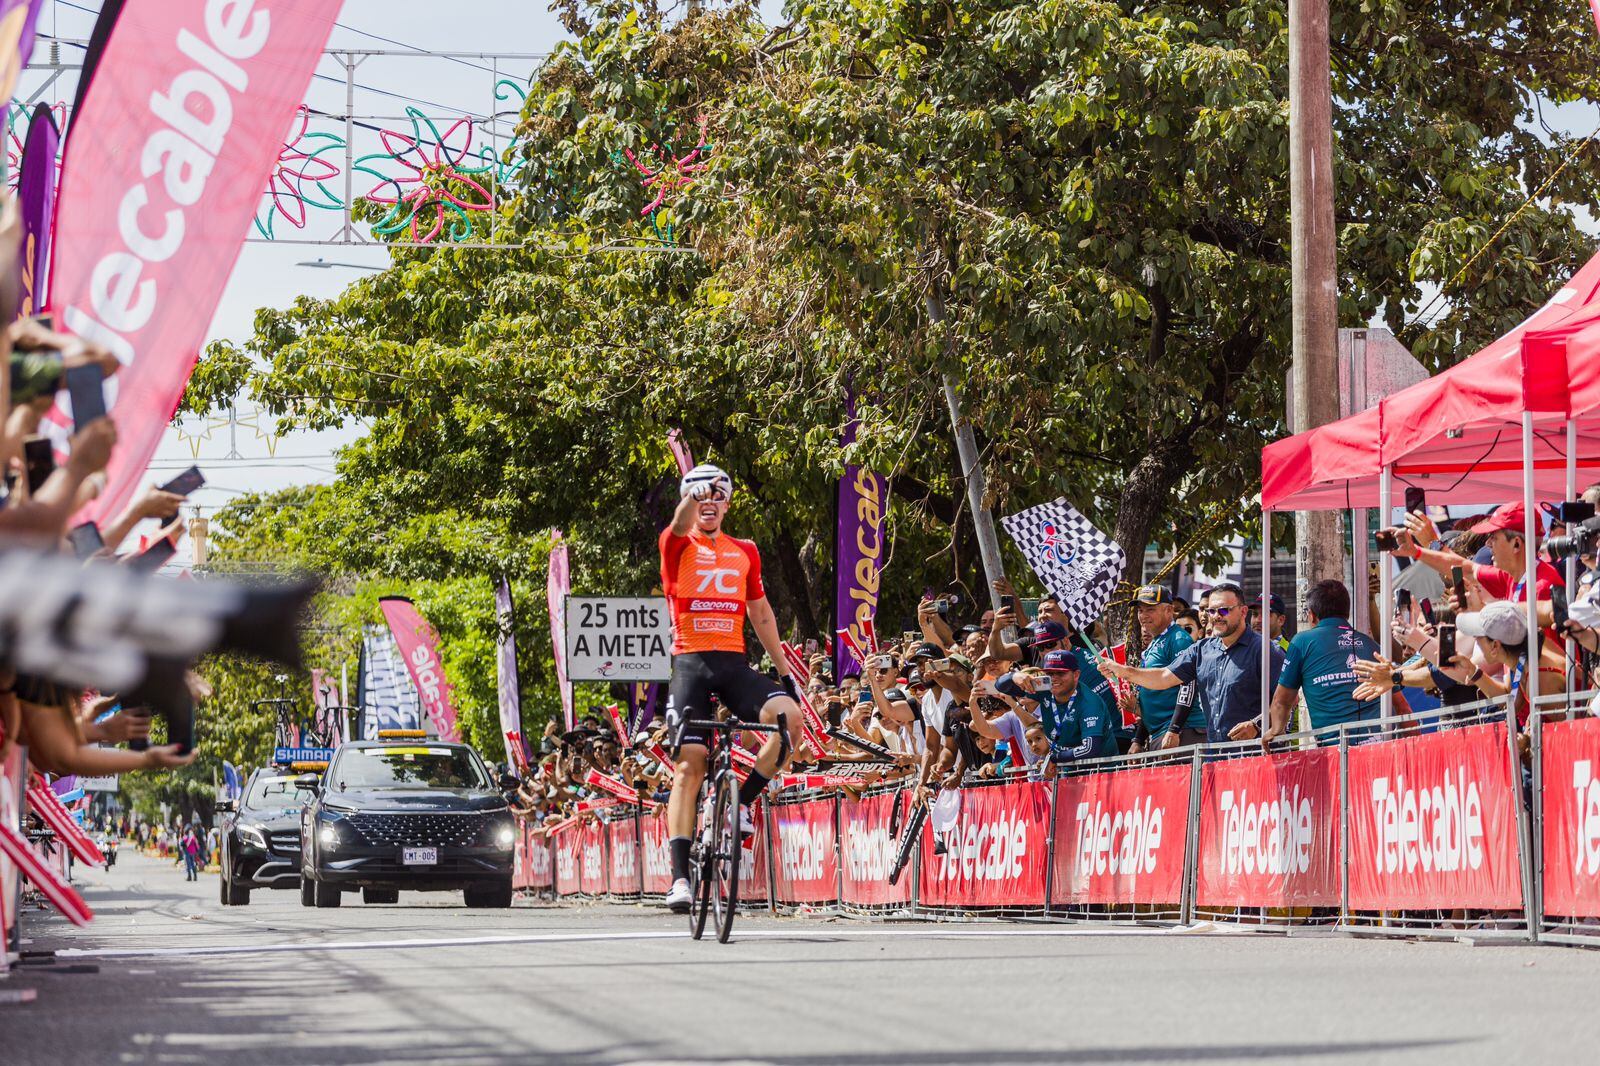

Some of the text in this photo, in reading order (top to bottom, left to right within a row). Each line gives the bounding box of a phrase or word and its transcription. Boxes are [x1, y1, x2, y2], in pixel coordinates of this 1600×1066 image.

[696, 568, 740, 594] 7C
[580, 603, 660, 628] 25 mts
[691, 600, 739, 612] Economy
[573, 634, 667, 657] A META
[620, 662, 652, 670] FECOCI
[1220, 783, 1313, 875] Telecable
[1372, 765, 1484, 875] Telecable
[1074, 795, 1164, 877] Telecable
[404, 851, 436, 861] CMT-005
